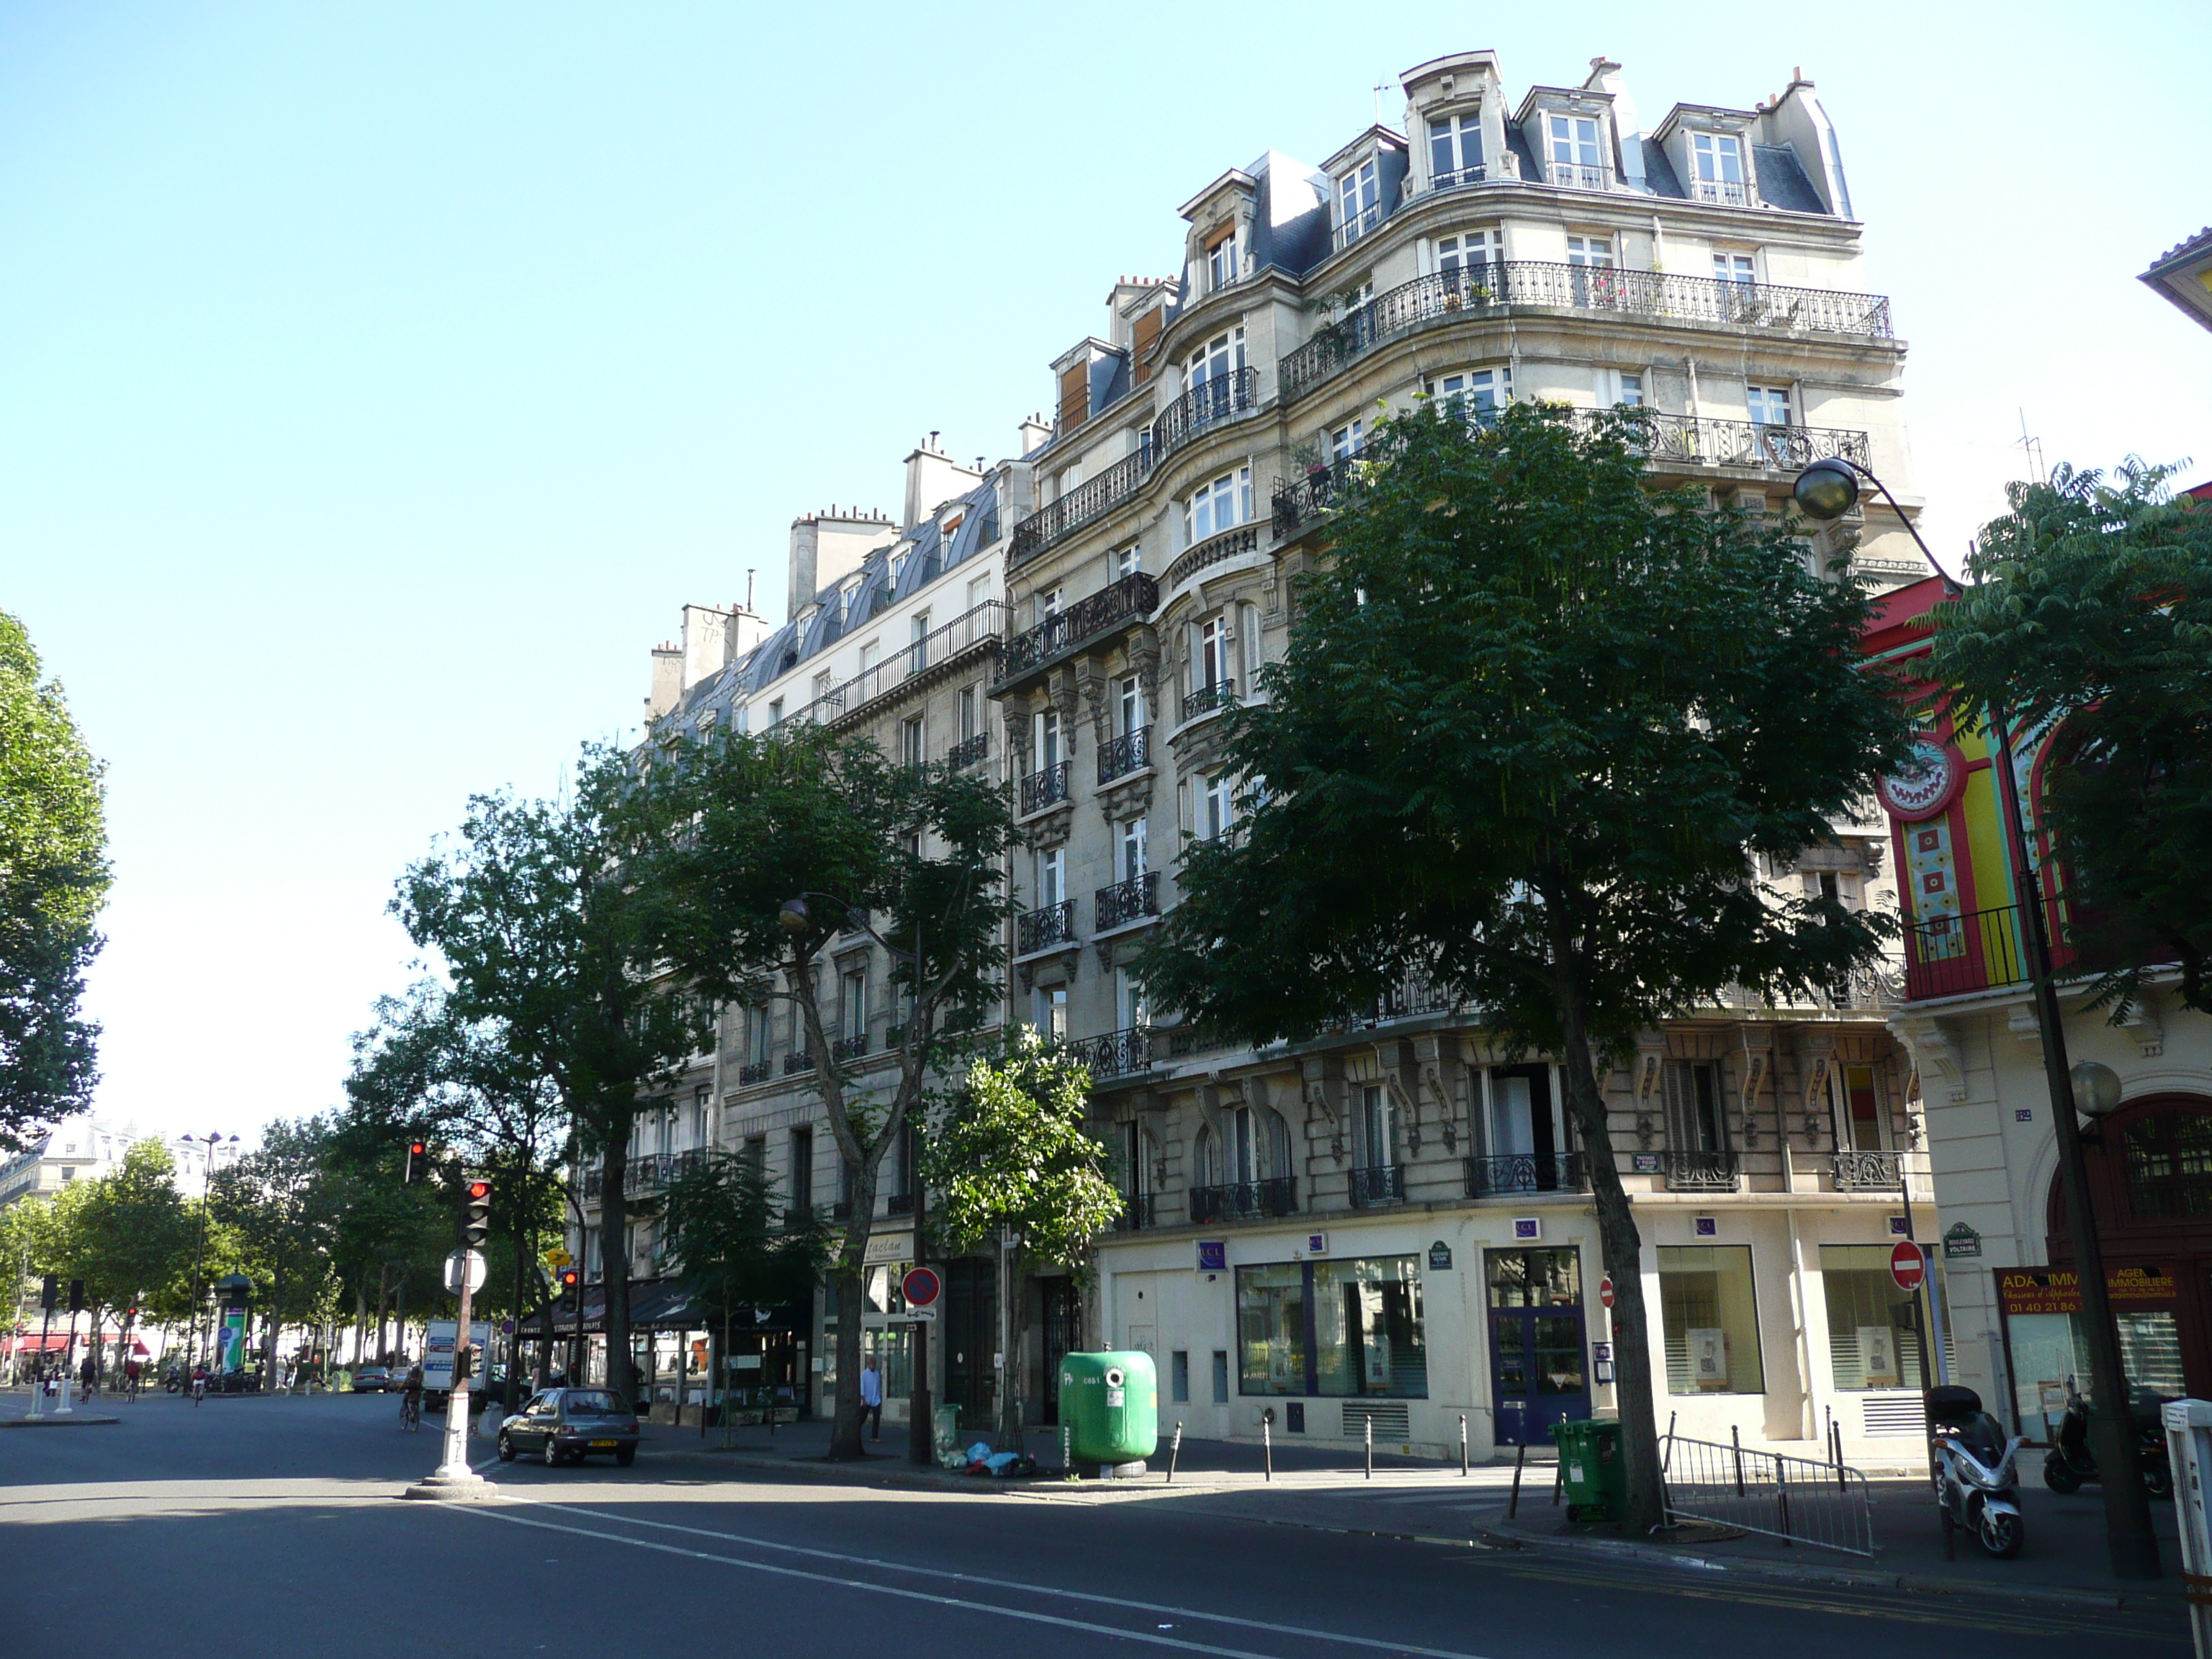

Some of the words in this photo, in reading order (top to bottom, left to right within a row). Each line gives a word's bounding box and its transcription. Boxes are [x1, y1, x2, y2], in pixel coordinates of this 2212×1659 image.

[868, 1238, 901, 1253] taclan
[1201, 1247, 1221, 1256] LCL
[2118, 1268, 2146, 1278] AGEN
[2002, 1275, 2038, 1287] ADA
[2048, 1272, 2078, 1286] IMM
[2108, 1277, 2174, 1287] IMMOBILIERE
[2010, 1303, 2022, 1312] 01
[2026, 1303, 2041, 1312] 40
[2045, 1303, 2057, 1311] 21
[2061, 1302, 2076, 1310] 86
